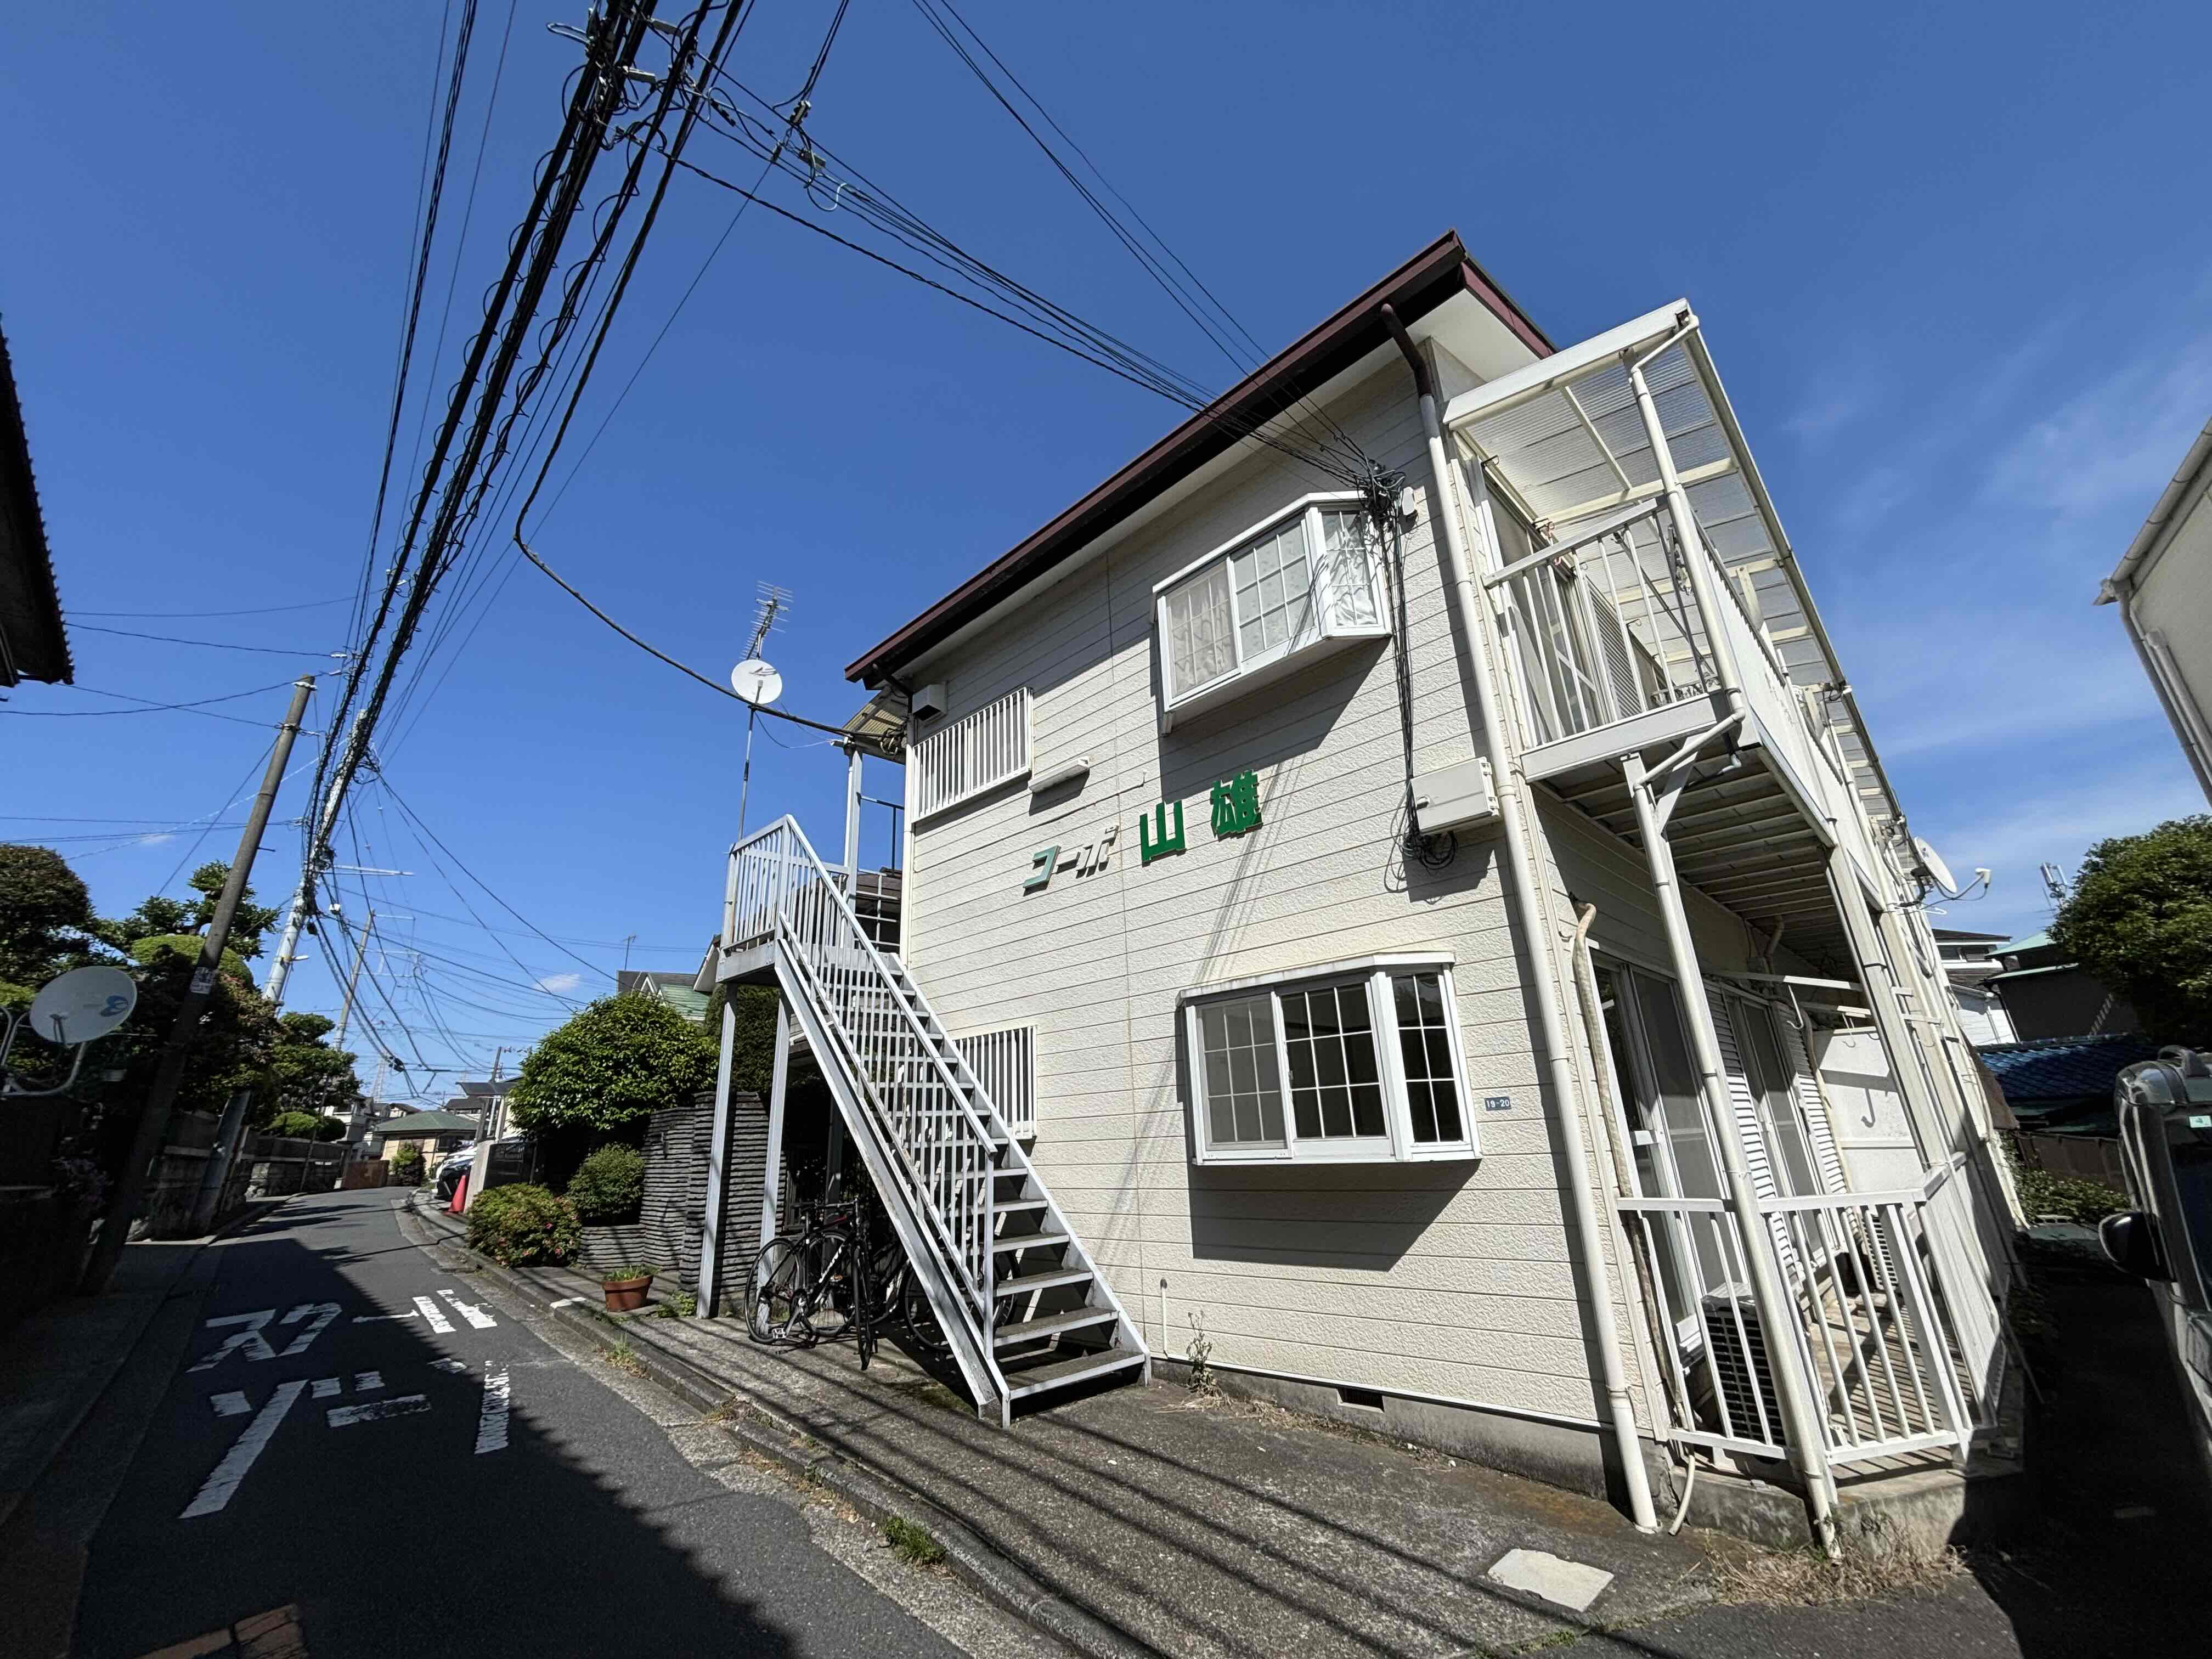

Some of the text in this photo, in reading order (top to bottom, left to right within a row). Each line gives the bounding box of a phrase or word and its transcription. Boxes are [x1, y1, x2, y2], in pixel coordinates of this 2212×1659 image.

[1486, 1099, 1510, 1108] 19-20
[186, 1289, 498, 1373] スクール
